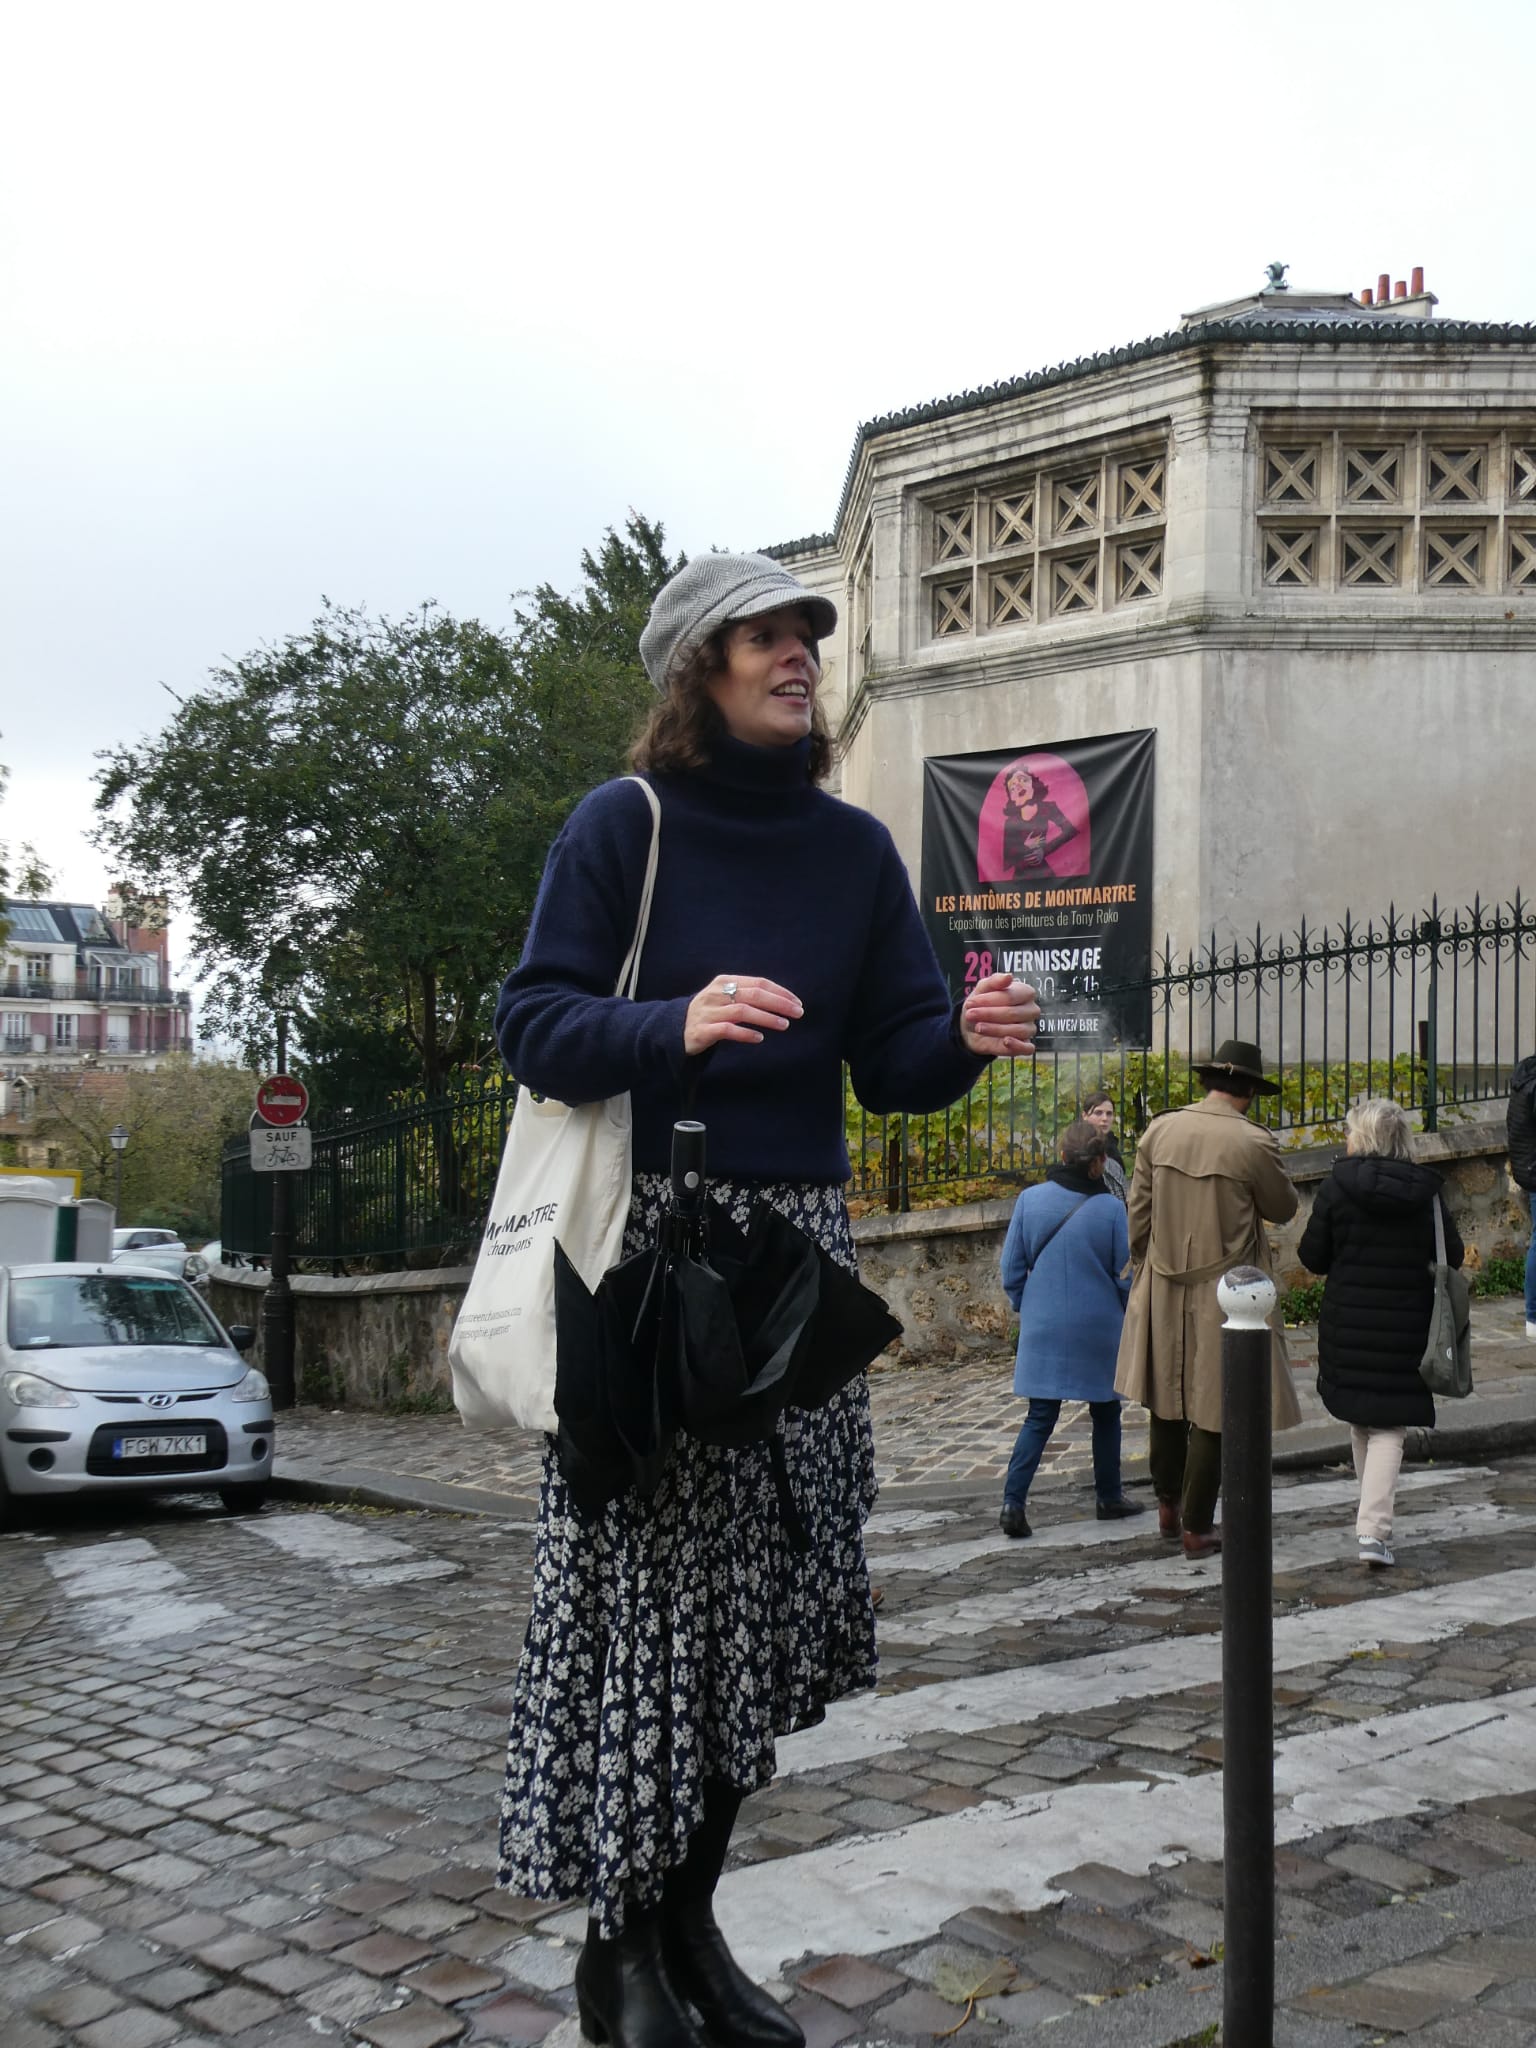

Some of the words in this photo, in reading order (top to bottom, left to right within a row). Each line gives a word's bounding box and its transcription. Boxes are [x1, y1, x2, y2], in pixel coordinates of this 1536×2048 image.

[936, 896, 956, 913] LES
[959, 889, 1021, 912] FANTÔMES
[1024, 891, 1042, 909] DE
[1044, 884, 1137, 907] MONTMARTRE
[949, 916, 993, 933] Exposition
[995, 915, 1010, 930] des
[1011, 913, 1054, 932] peintures
[1056, 912, 1069, 926] de
[1071, 910, 1094, 928] Tony
[1096, 908, 1119, 924] Roko
[964, 951, 993, 982] 28
[1003, 947, 1102, 973] VERNISSAGE
[266, 1131, 298, 1142] SAUF
[124, 1438, 158, 1455] FGW
[164, 1435, 203, 1454] 7KK1
